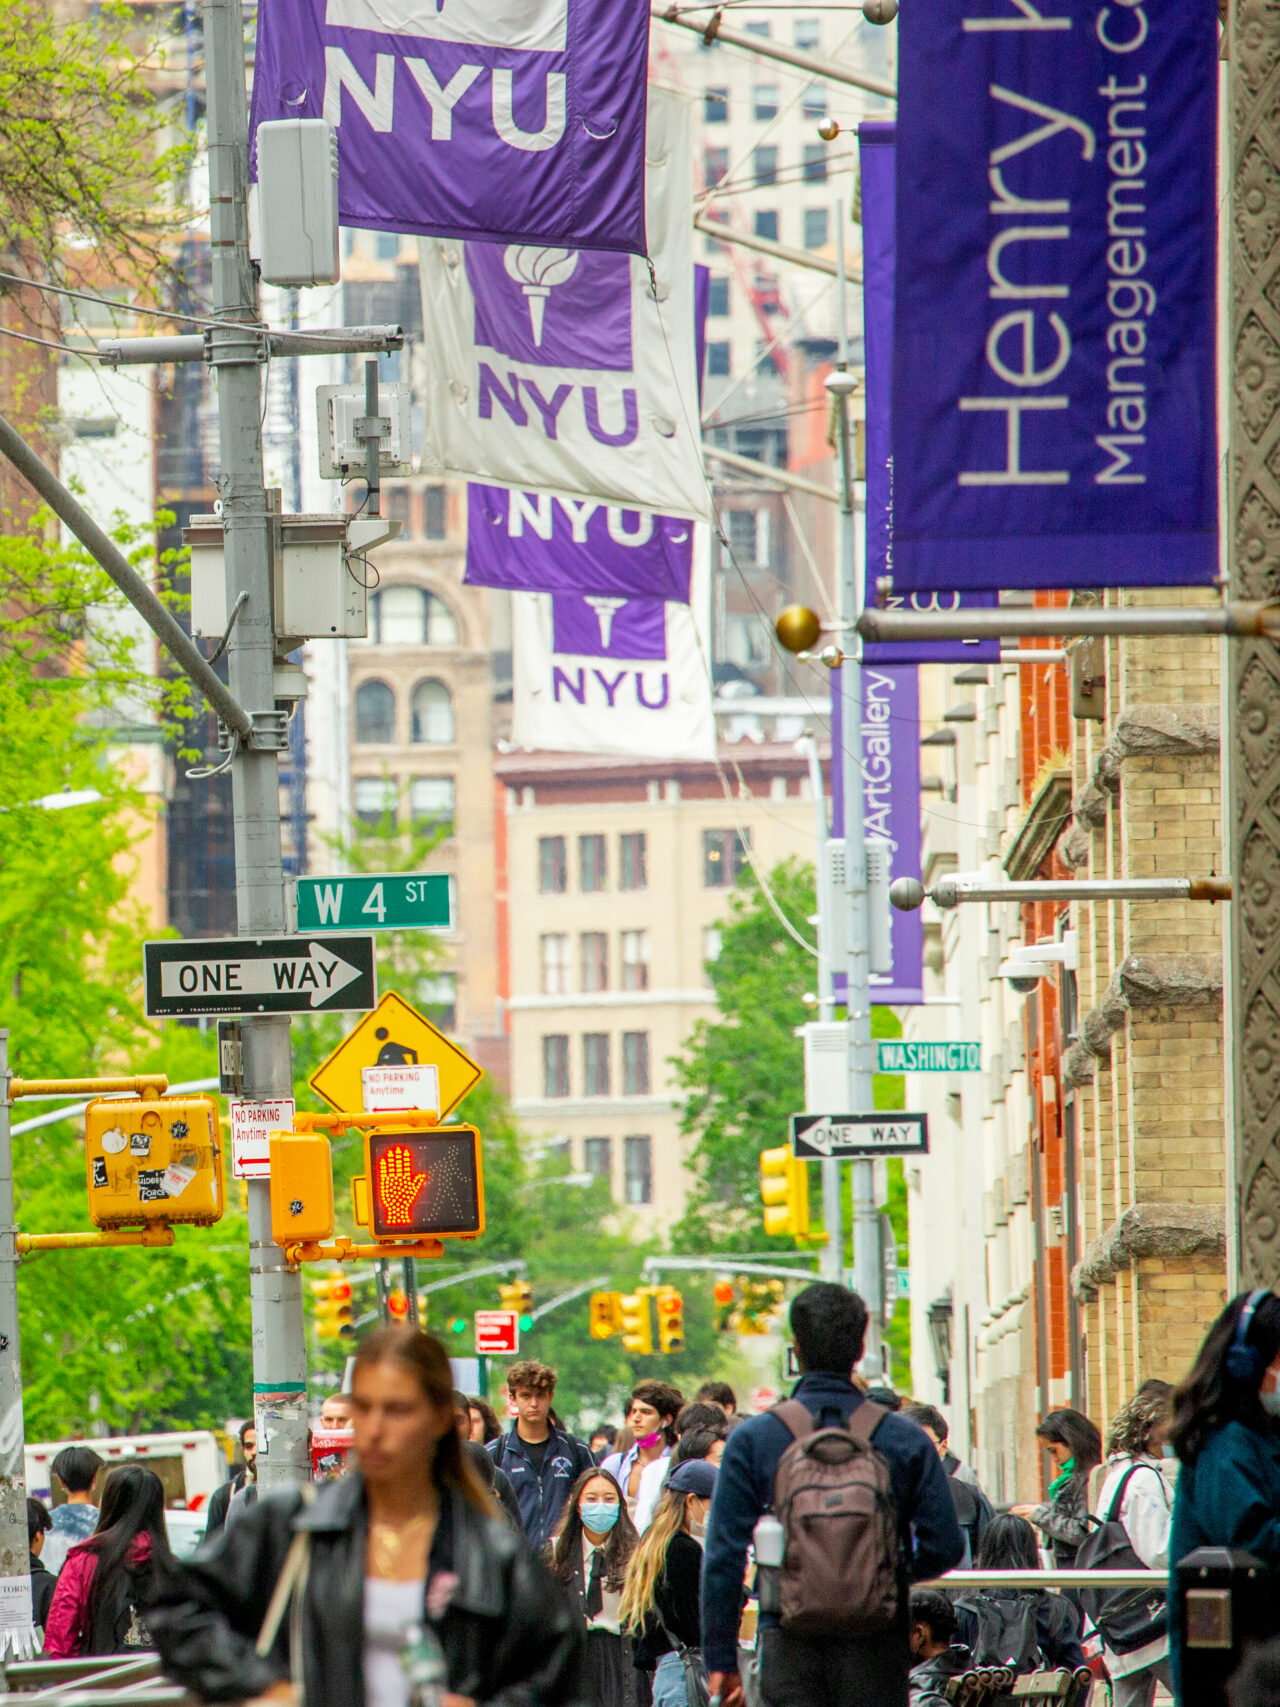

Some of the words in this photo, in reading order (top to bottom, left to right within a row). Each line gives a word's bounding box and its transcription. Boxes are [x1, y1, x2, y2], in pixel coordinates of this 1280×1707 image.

[322, 46, 567, 151] NYU
[958, 84, 1096, 486] Henry
[1095, 74, 1156, 485] Management
[478, 362, 638, 447] NYU
[508, 488, 653, 547] NYU
[552, 665, 669, 710] NYU
[314, 884, 343, 924] W
[362, 882, 387, 923] 4
[405, 881, 428, 903] ST
[179, 964, 243, 993] ONE
[273, 960, 339, 990] WAY
[368, 1073, 382, 1082] NO
[383, 1071, 420, 1082] PARKING
[370, 1085, 405, 1096] Anytime
[235, 1110, 246, 1124] NO
[248, 1108, 280, 1123] PARKING
[236, 1126, 267, 1146] Anytime
[814, 1127, 852, 1144] ONE
[871, 1126, 911, 1142] WAY
